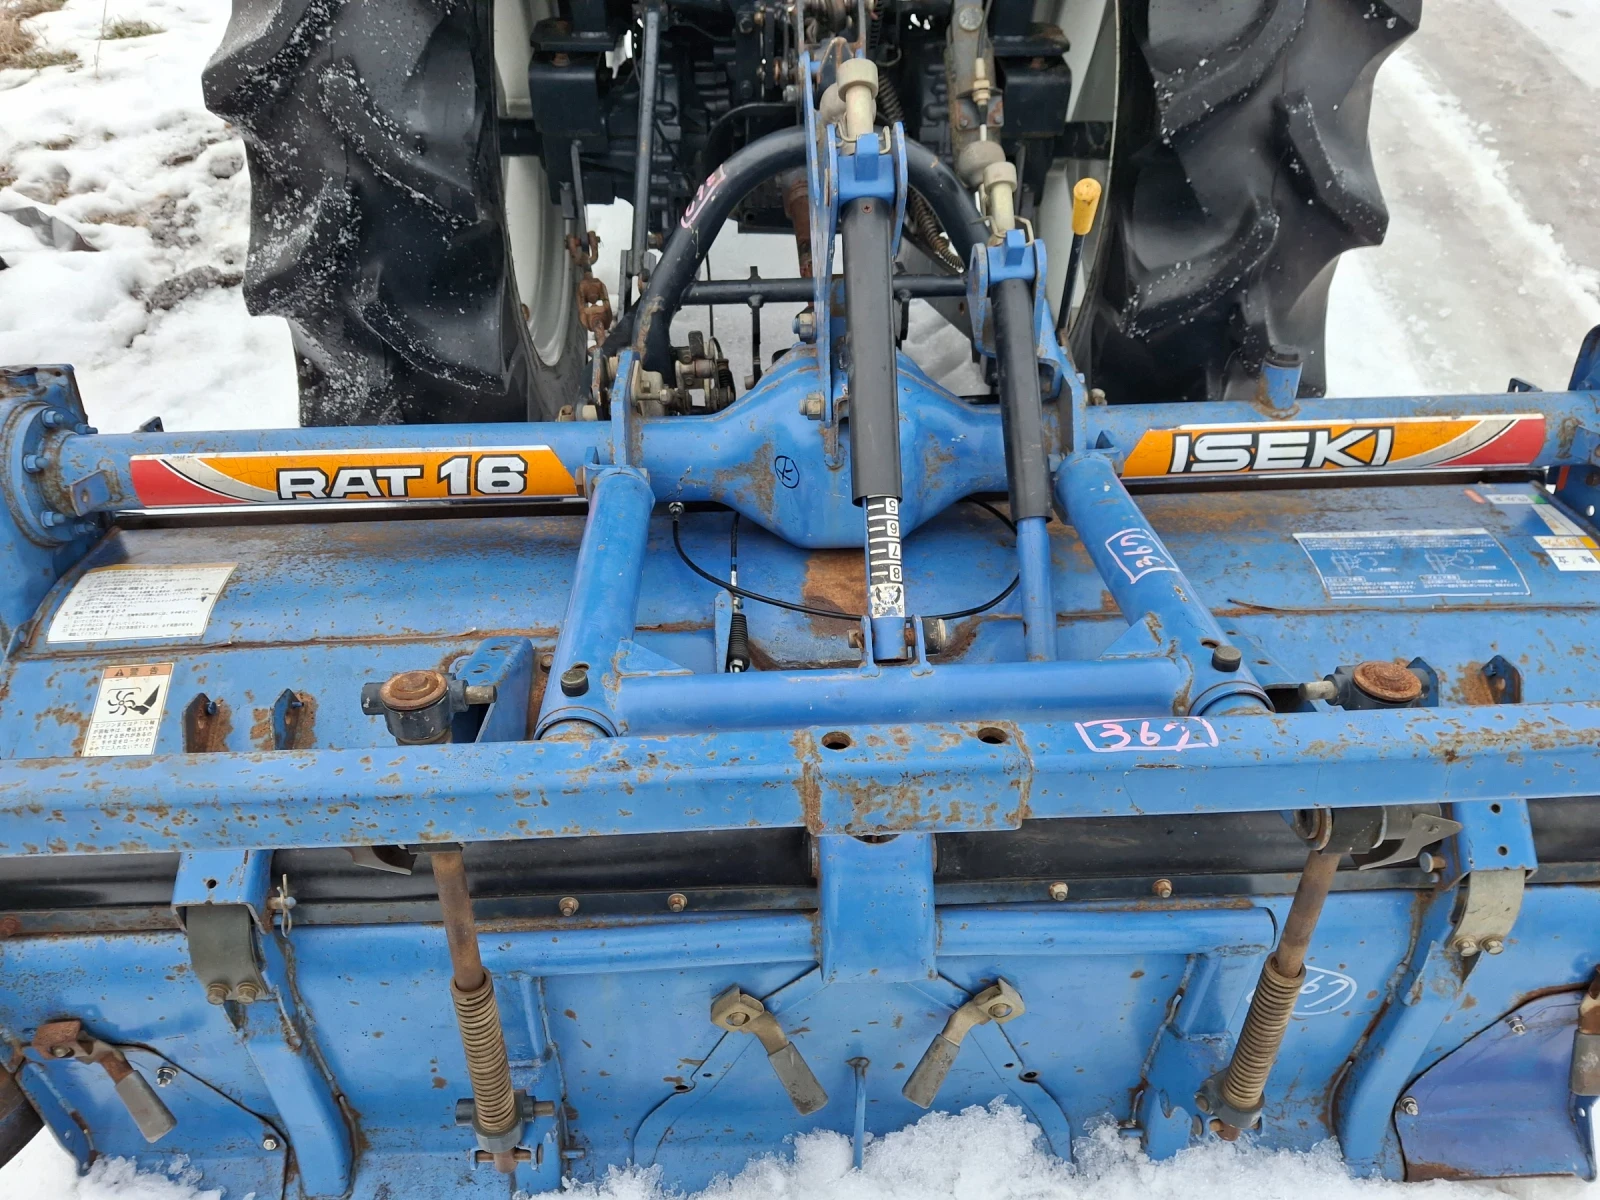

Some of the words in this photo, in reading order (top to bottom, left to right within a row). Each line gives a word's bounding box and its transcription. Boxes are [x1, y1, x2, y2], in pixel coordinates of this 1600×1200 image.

[1170, 427, 1394, 473] ISEKI
[276, 466, 422, 500] RAT
[438, 454, 527, 495] 16
[889, 500, 896, 512] 5
[890, 523, 898, 534] 6
[892, 545, 899, 556] 7
[893, 567, 900, 579] 8
[1099, 721, 1190, 751] 367
[1299, 974, 1350, 1008] 67
